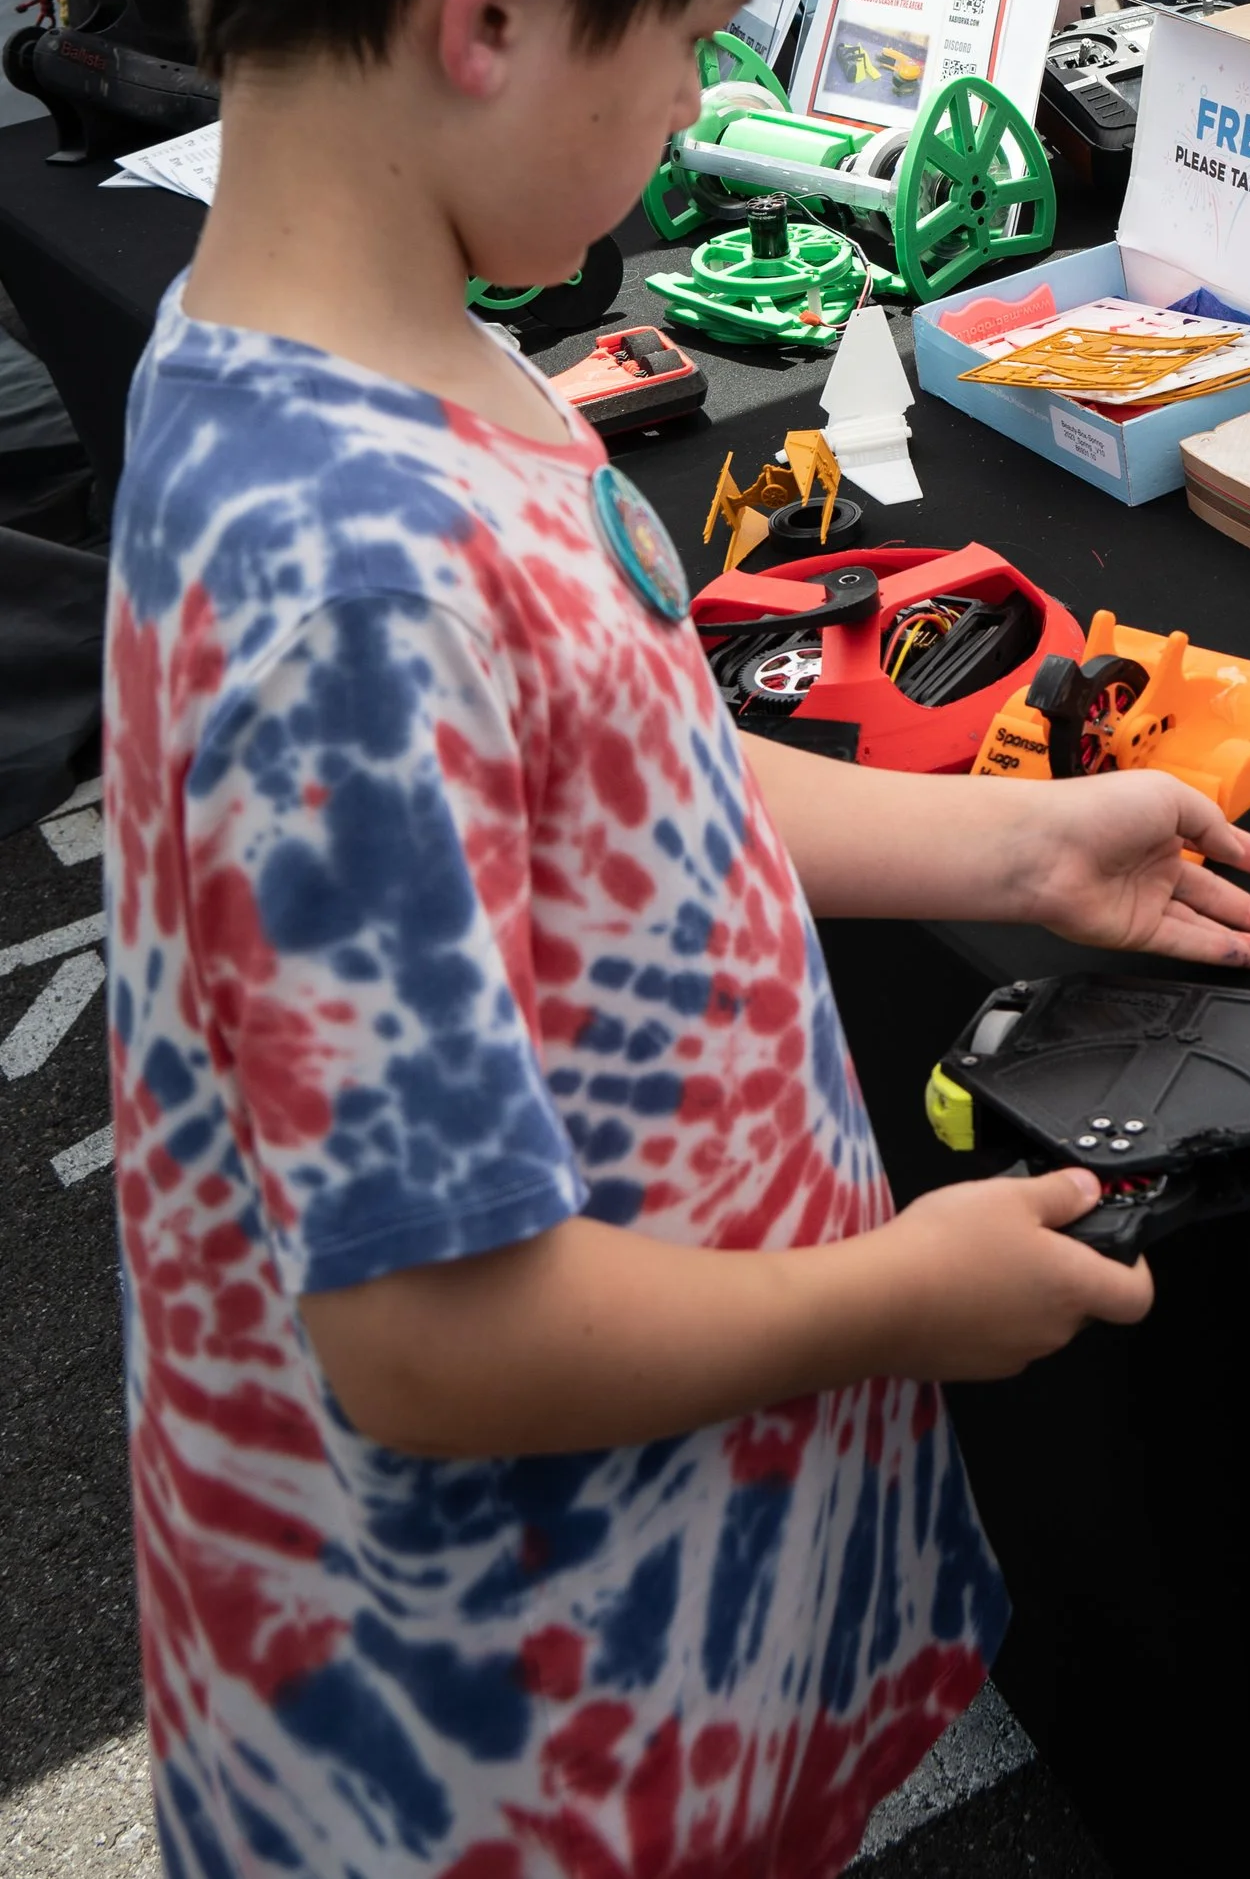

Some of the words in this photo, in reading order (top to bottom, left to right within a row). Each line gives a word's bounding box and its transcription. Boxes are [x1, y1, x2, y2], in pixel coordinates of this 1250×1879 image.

[61, 41, 107, 69] Ballista
[944, 39, 971, 54] DISCORD
[1175, 145, 1226, 182] PLEASE
[995, 727, 1049, 755] Sponsor
[987, 746, 1020, 770] Logo
